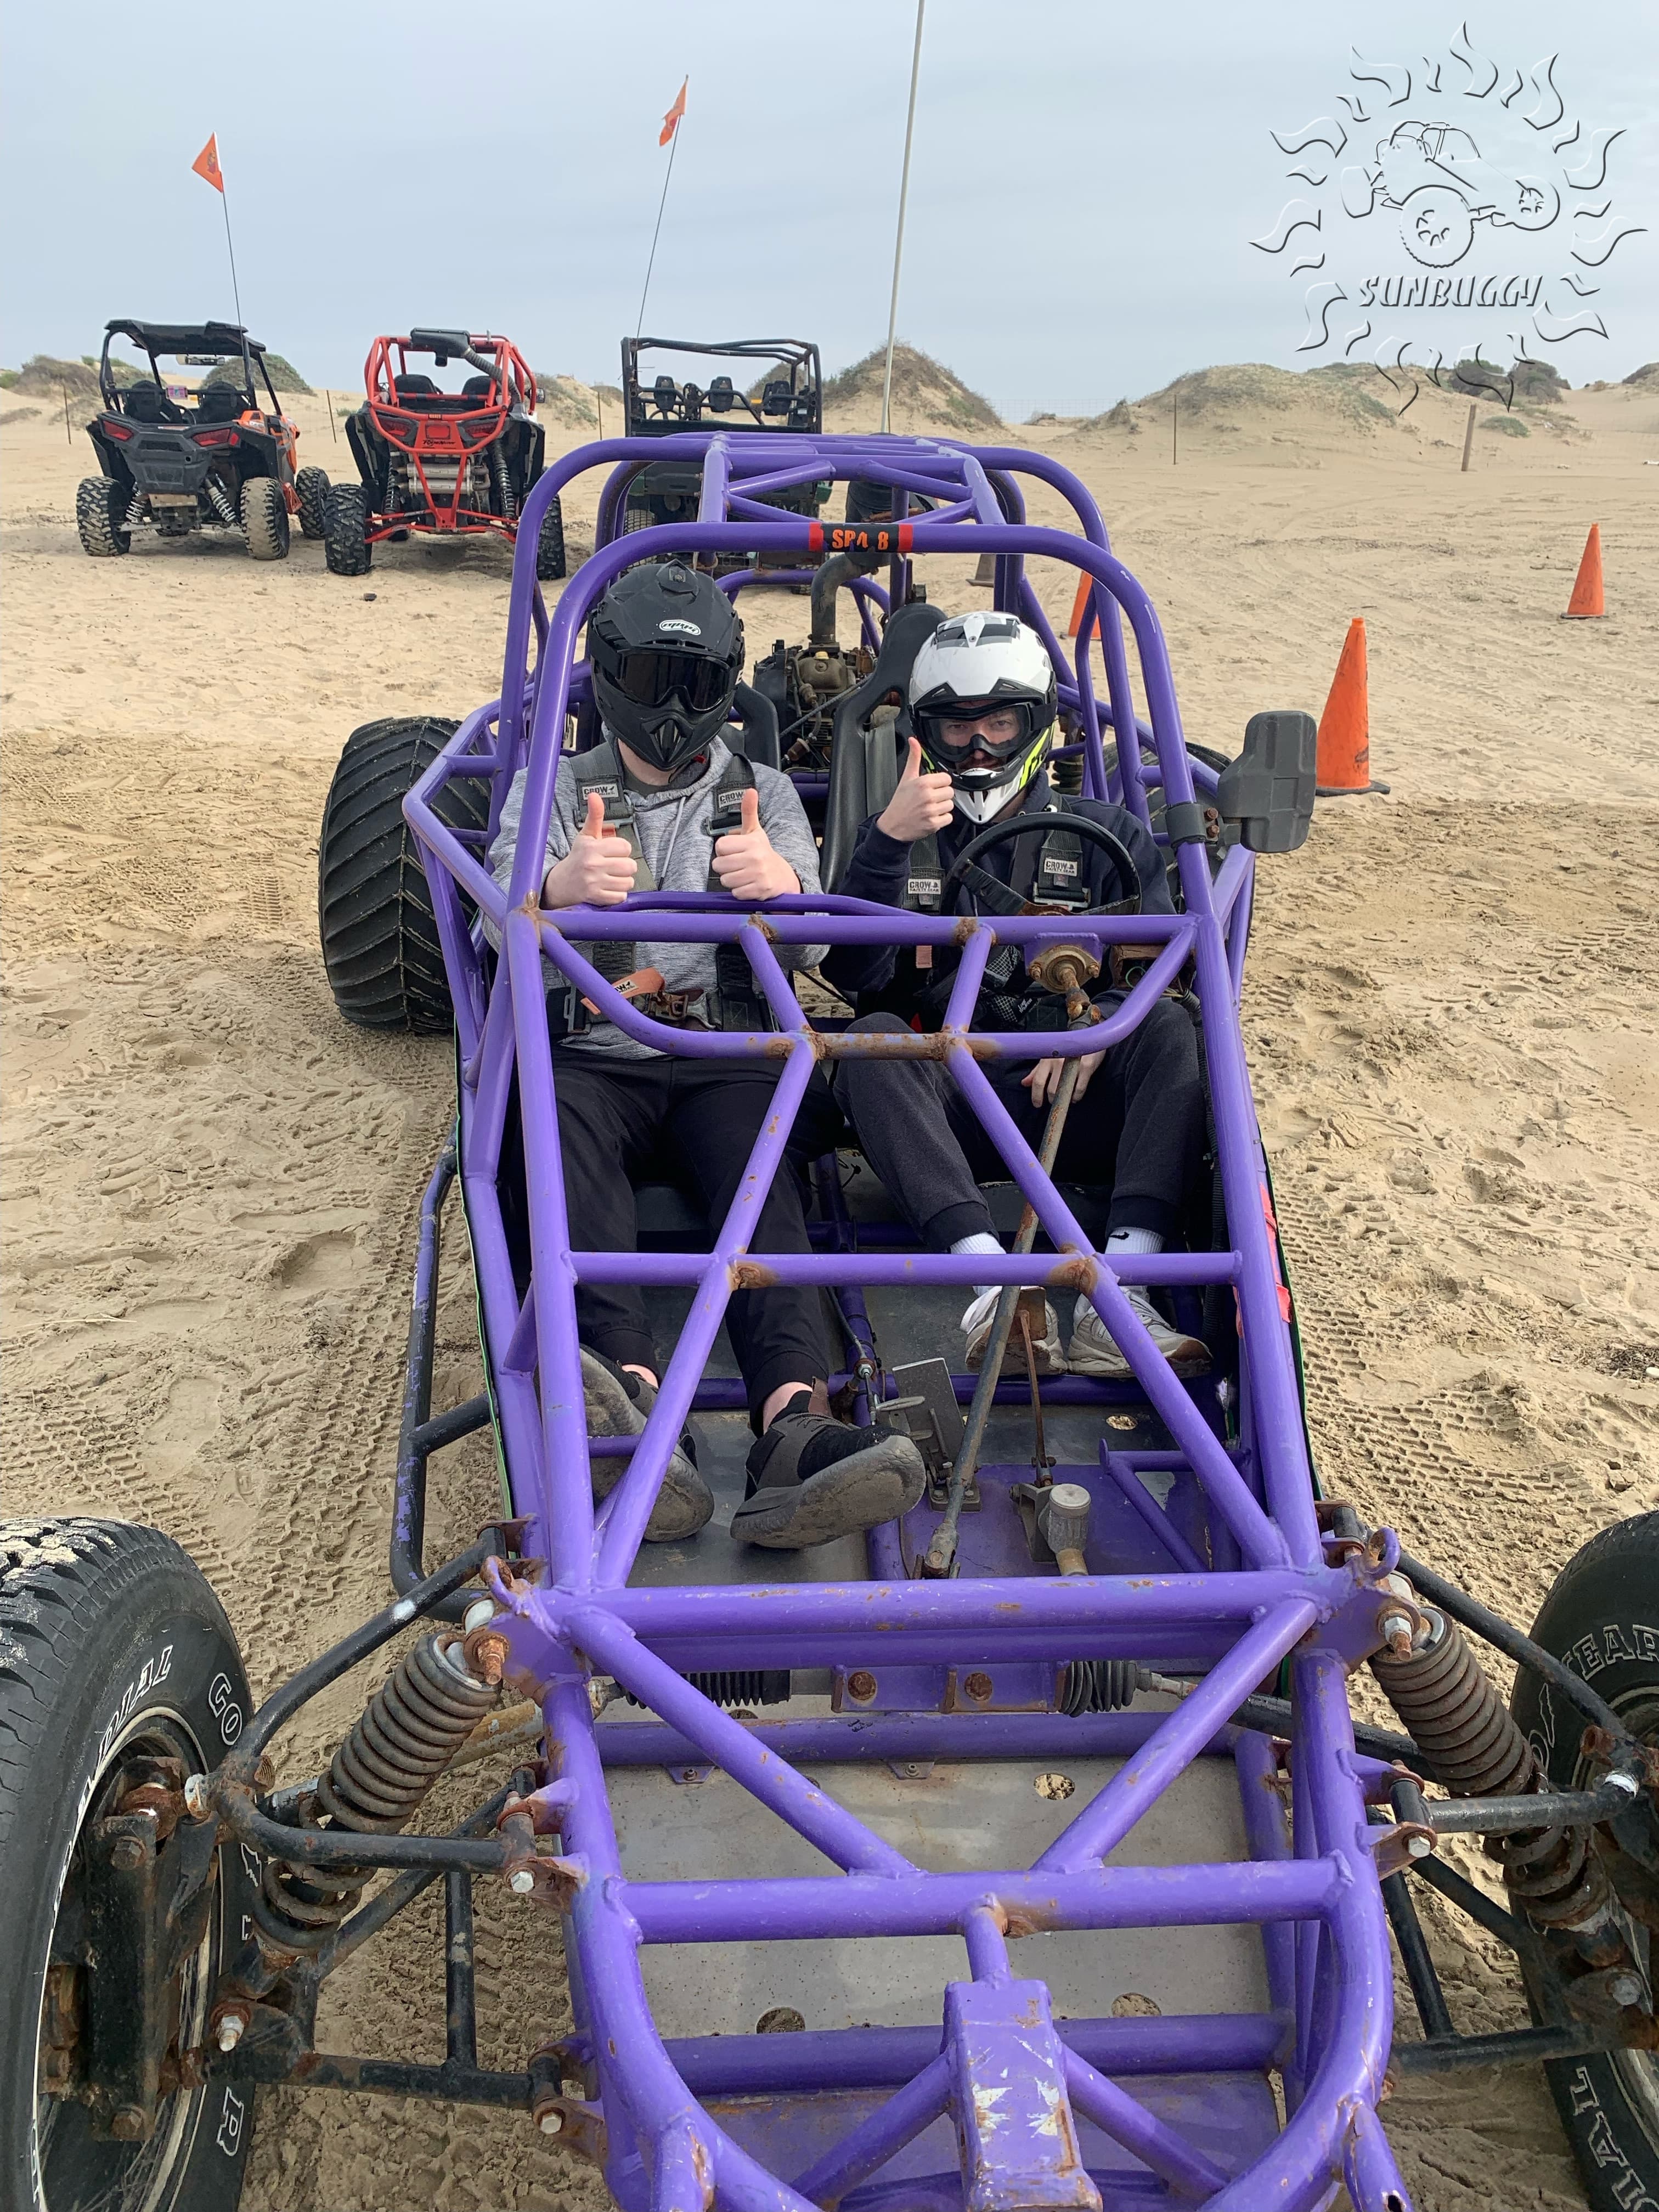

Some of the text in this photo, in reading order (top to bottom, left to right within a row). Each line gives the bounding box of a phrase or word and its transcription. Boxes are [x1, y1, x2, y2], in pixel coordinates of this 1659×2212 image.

[878, 531, 889, 550] 8
[720, 792, 744, 802] CROW
[1045, 861, 1068, 869] CROW
[1561, 1624, 1659, 1681] EAR
[208, 1673, 242, 1746] GO
